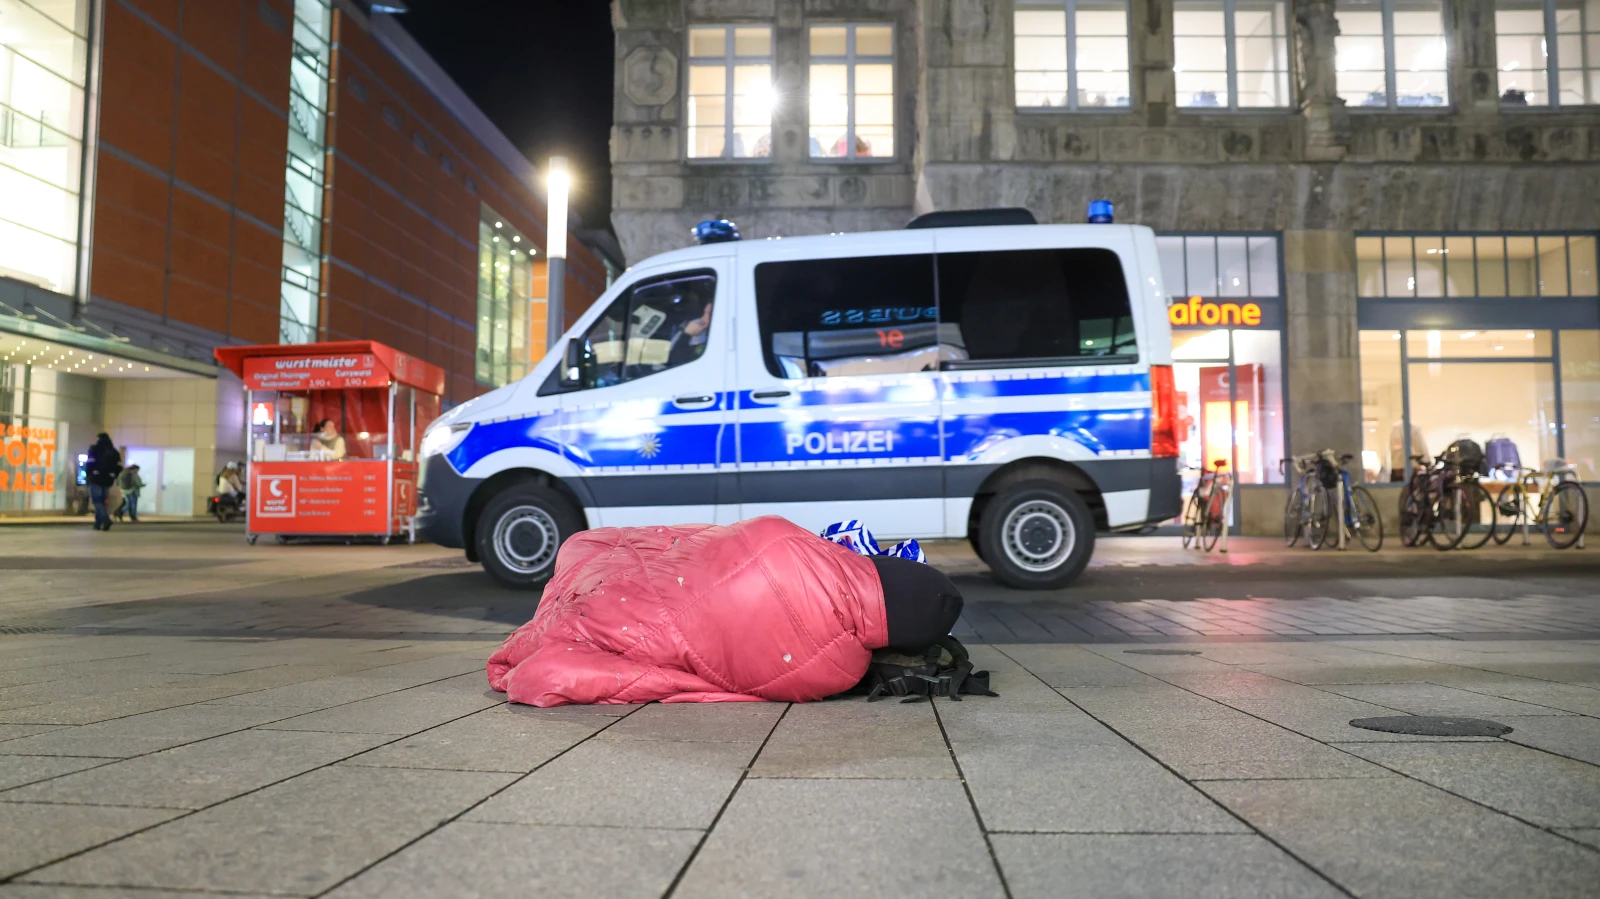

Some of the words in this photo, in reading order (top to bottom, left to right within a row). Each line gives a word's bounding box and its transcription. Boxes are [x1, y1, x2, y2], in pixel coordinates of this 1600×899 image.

[1168, 296, 1262, 325] afone
[786, 430, 893, 455] POLIZEI
[12, 471, 55, 492] ALLE
